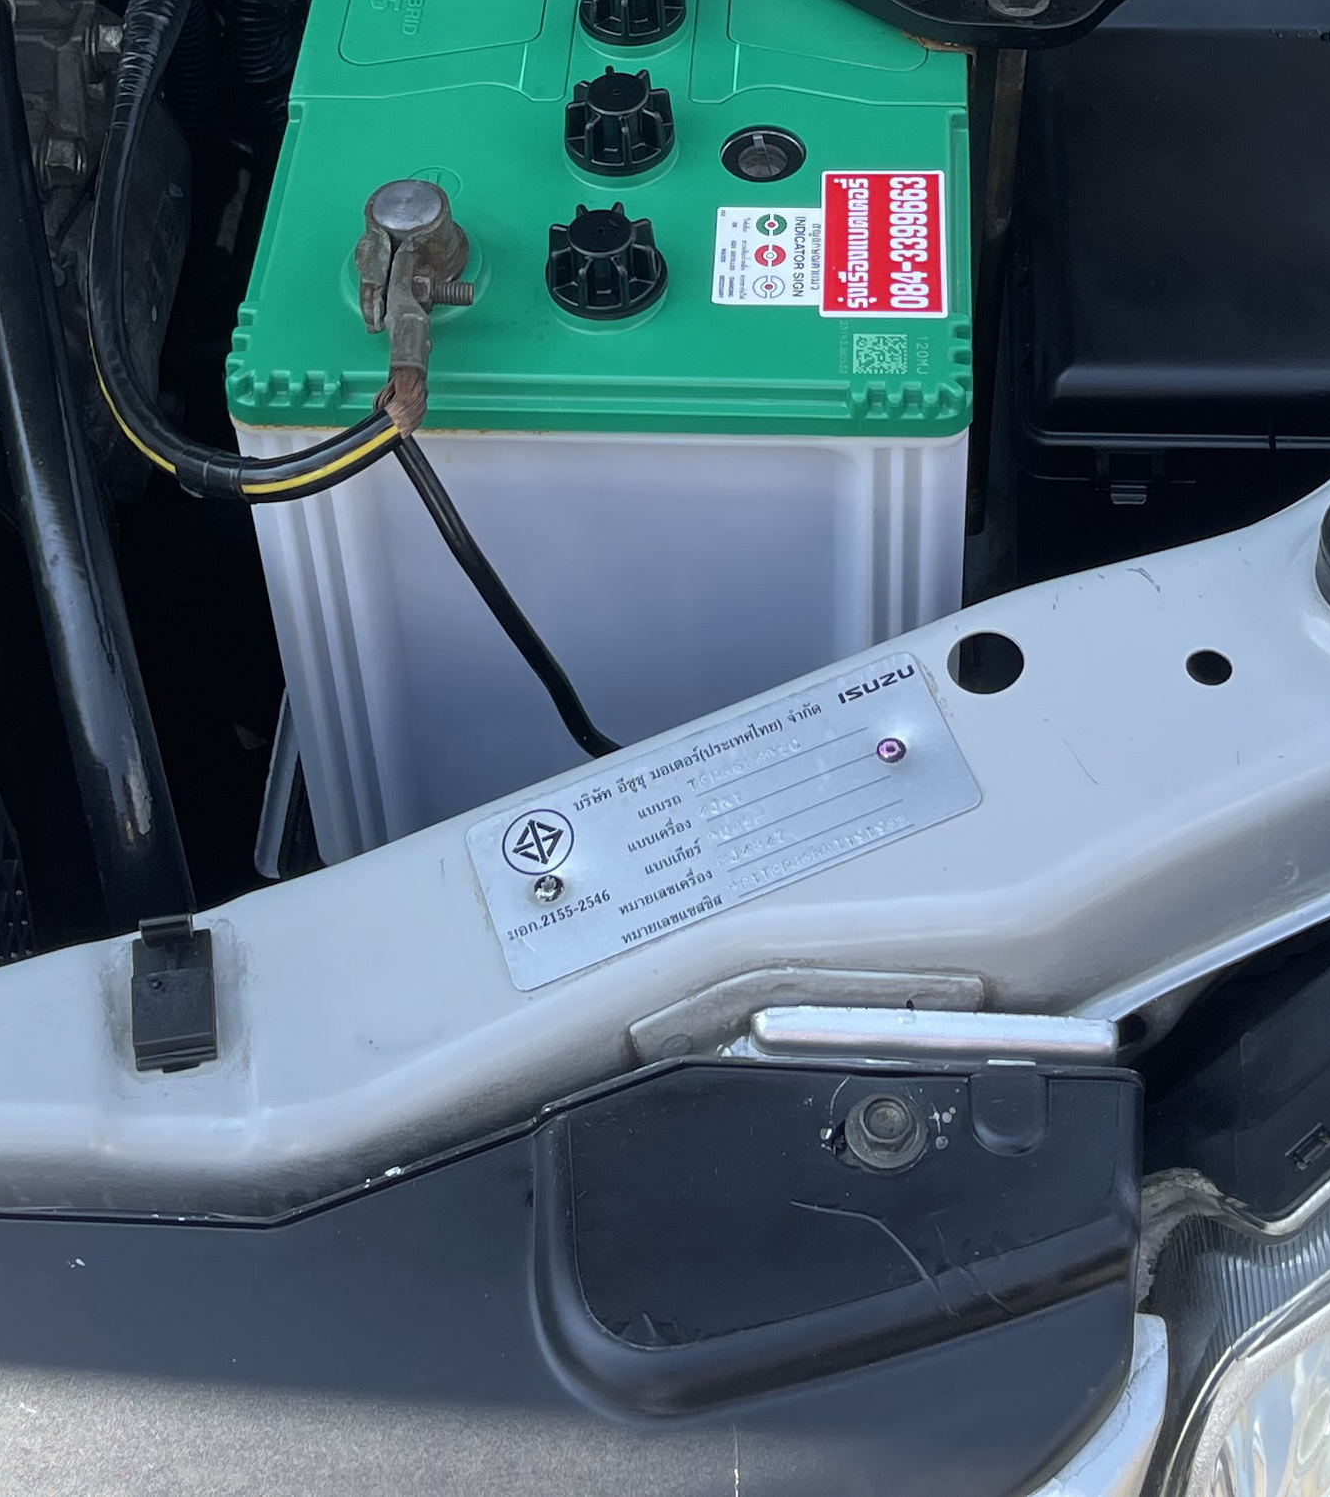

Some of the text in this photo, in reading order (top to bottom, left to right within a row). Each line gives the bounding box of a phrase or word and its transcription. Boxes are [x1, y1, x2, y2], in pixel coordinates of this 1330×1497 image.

[792, 216, 806, 298] INDICATOR SIGN
[833, 178, 878, 309] รุ่งเรืองแบตเตอรี่
[889, 176, 928, 309] 084-3399663
[916, 336, 930, 375] 120MJ
[837, 663, 916, 705] ISUZU
[572, 783, 614, 812] บริษัท
[615, 770, 648, 798] อีซูซุ
[650, 719, 784, 781] มอเตอร์(ประเทศไทย)
[785, 698, 822, 726] จำกัด
[636, 792, 683, 820] แบบรถ
[626, 816, 693, 853] แบบเครื่อง
[644, 839, 703, 876] แบบเกียร์
[507, 889, 611, 941] มอก.2155-2546
[617, 867, 713, 916] หมายเลขเครื่อง
